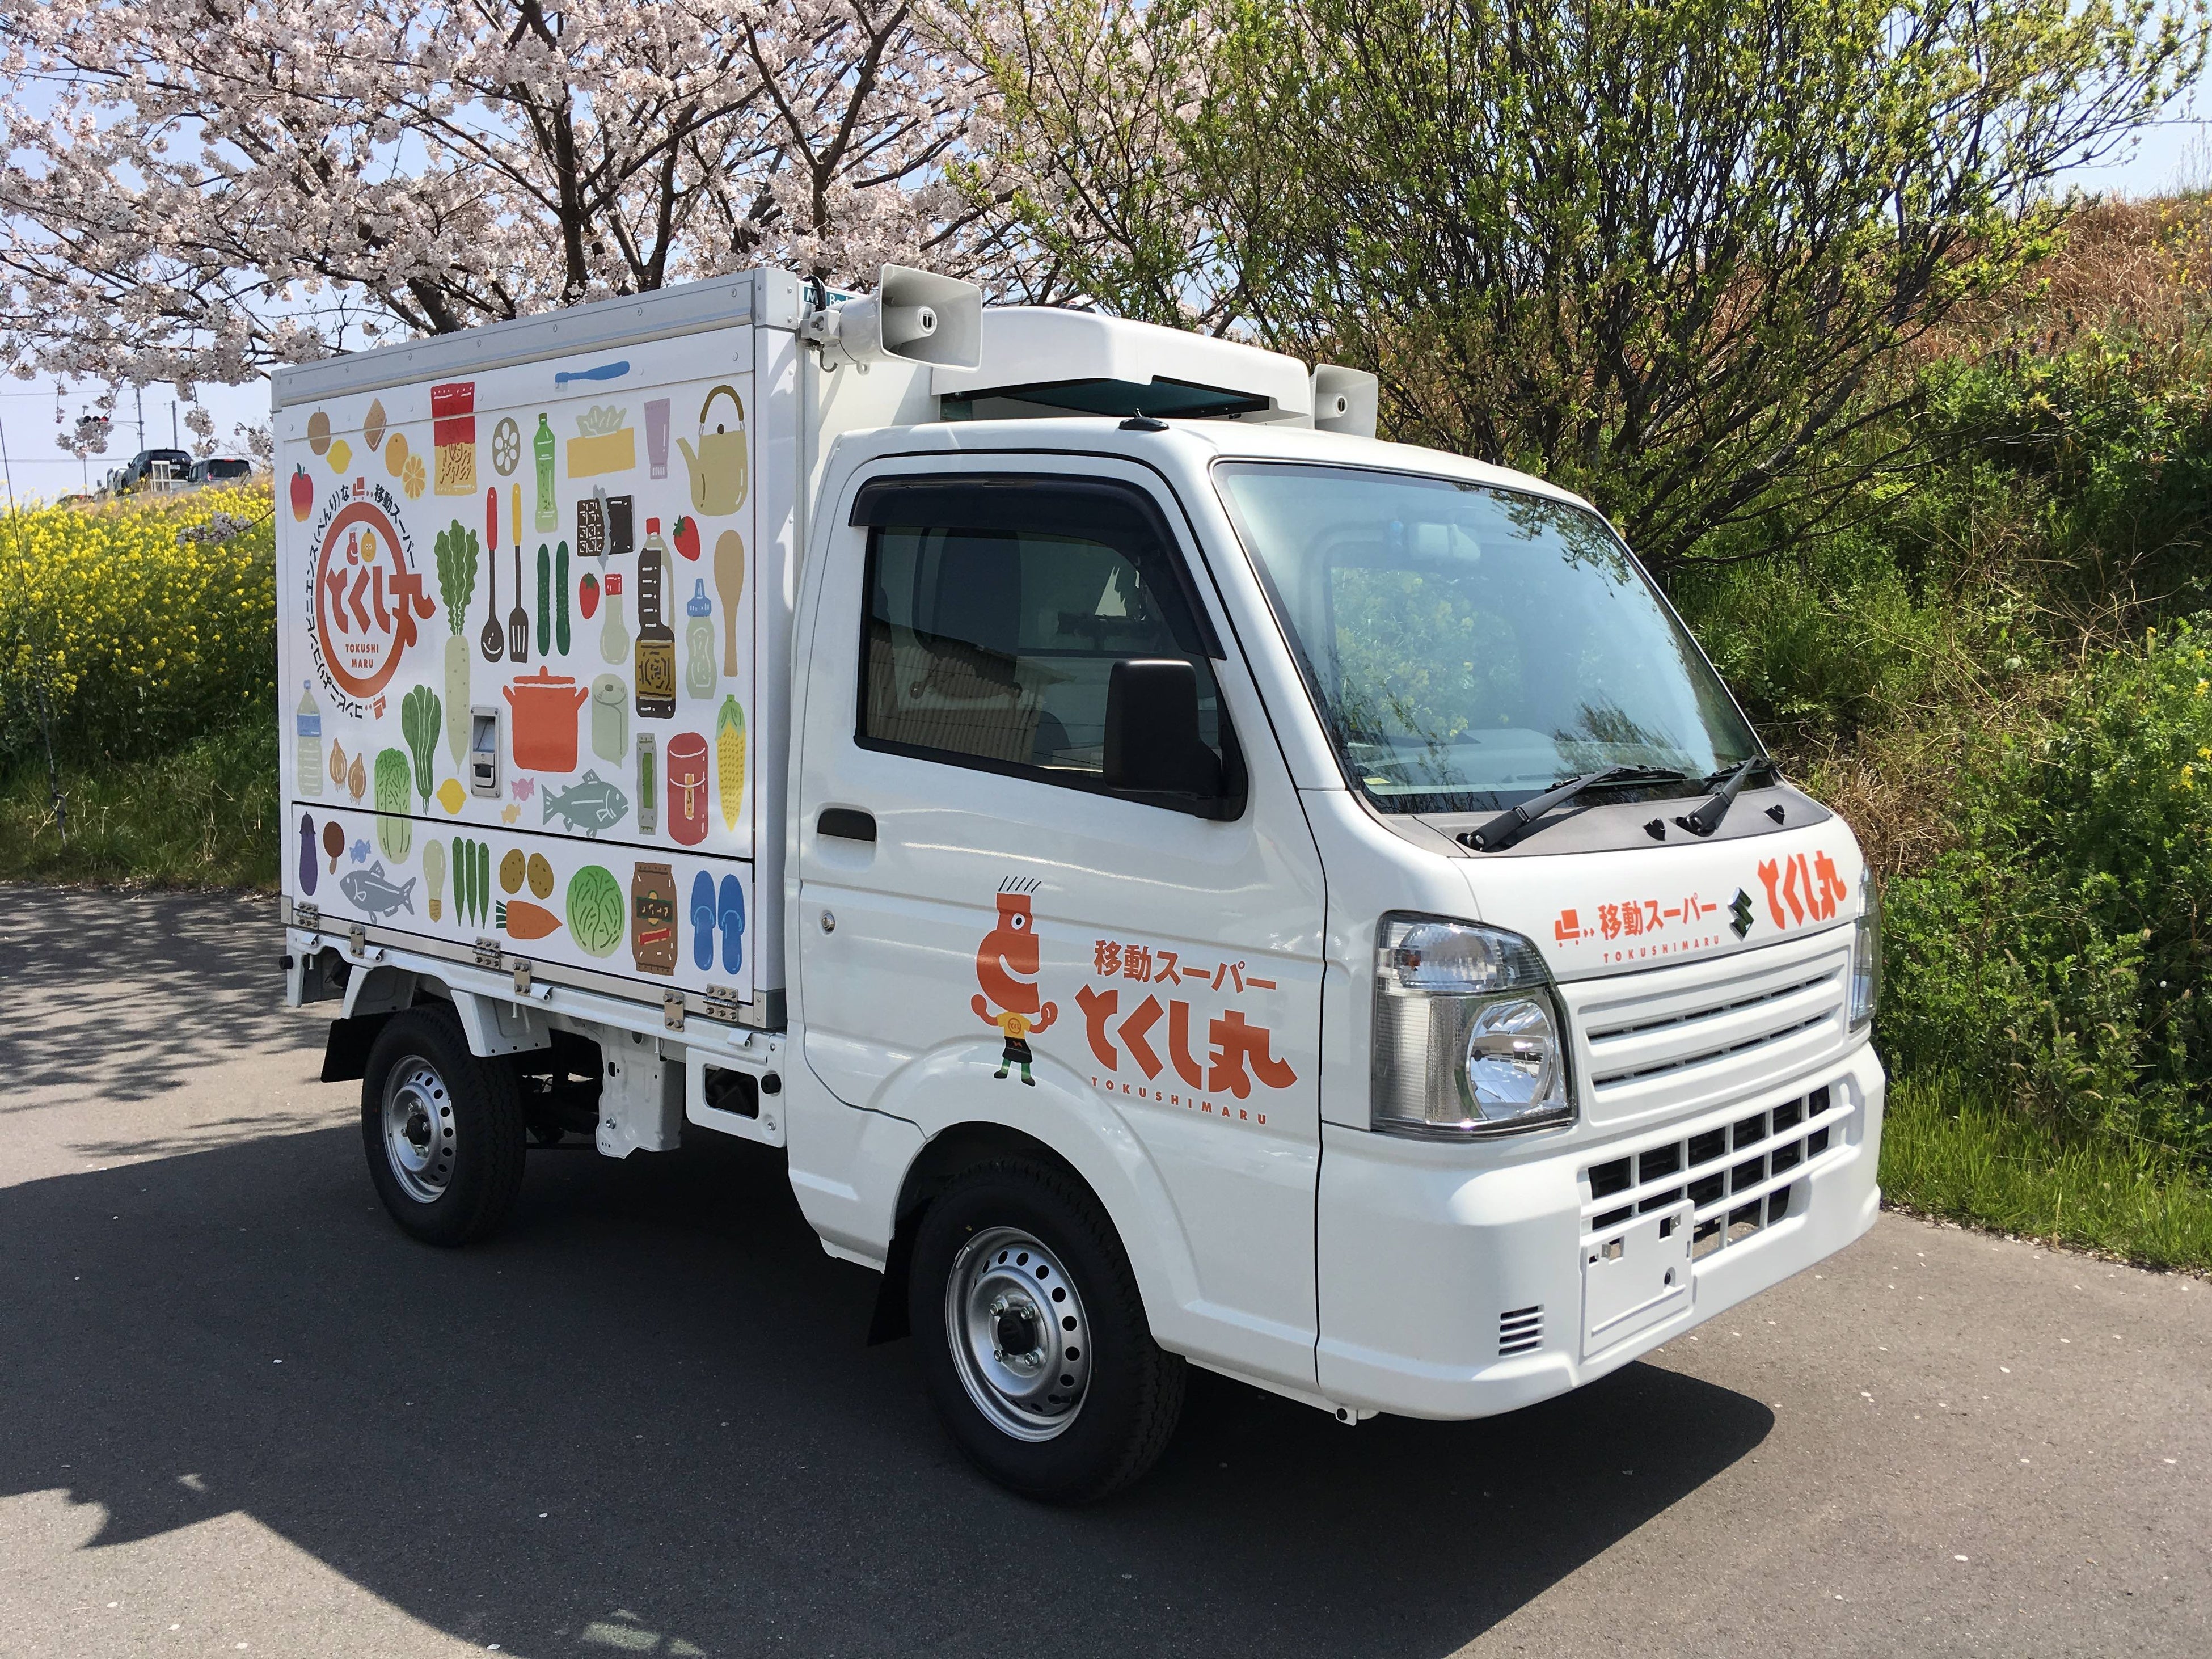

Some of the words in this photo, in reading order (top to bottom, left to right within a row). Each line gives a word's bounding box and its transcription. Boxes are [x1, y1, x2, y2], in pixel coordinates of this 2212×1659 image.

[374, 484, 415, 568] 移動スーパー
[326, 565, 436, 648] とくし丸
[345, 643, 379, 654] TOKUSHI
[351, 658, 373, 668] MARU
[1757, 850, 1847, 930] とくし丸
[1598, 892, 1717, 941] 移動スーパー
[1094, 940, 1276, 994] 移動スーパー
[1603, 935, 1720, 963] TOKUSHIMARU
[1074, 983, 1298, 1099] とくし丸
[1091, 1077, 1266, 1125] TOKUSHIMARU
